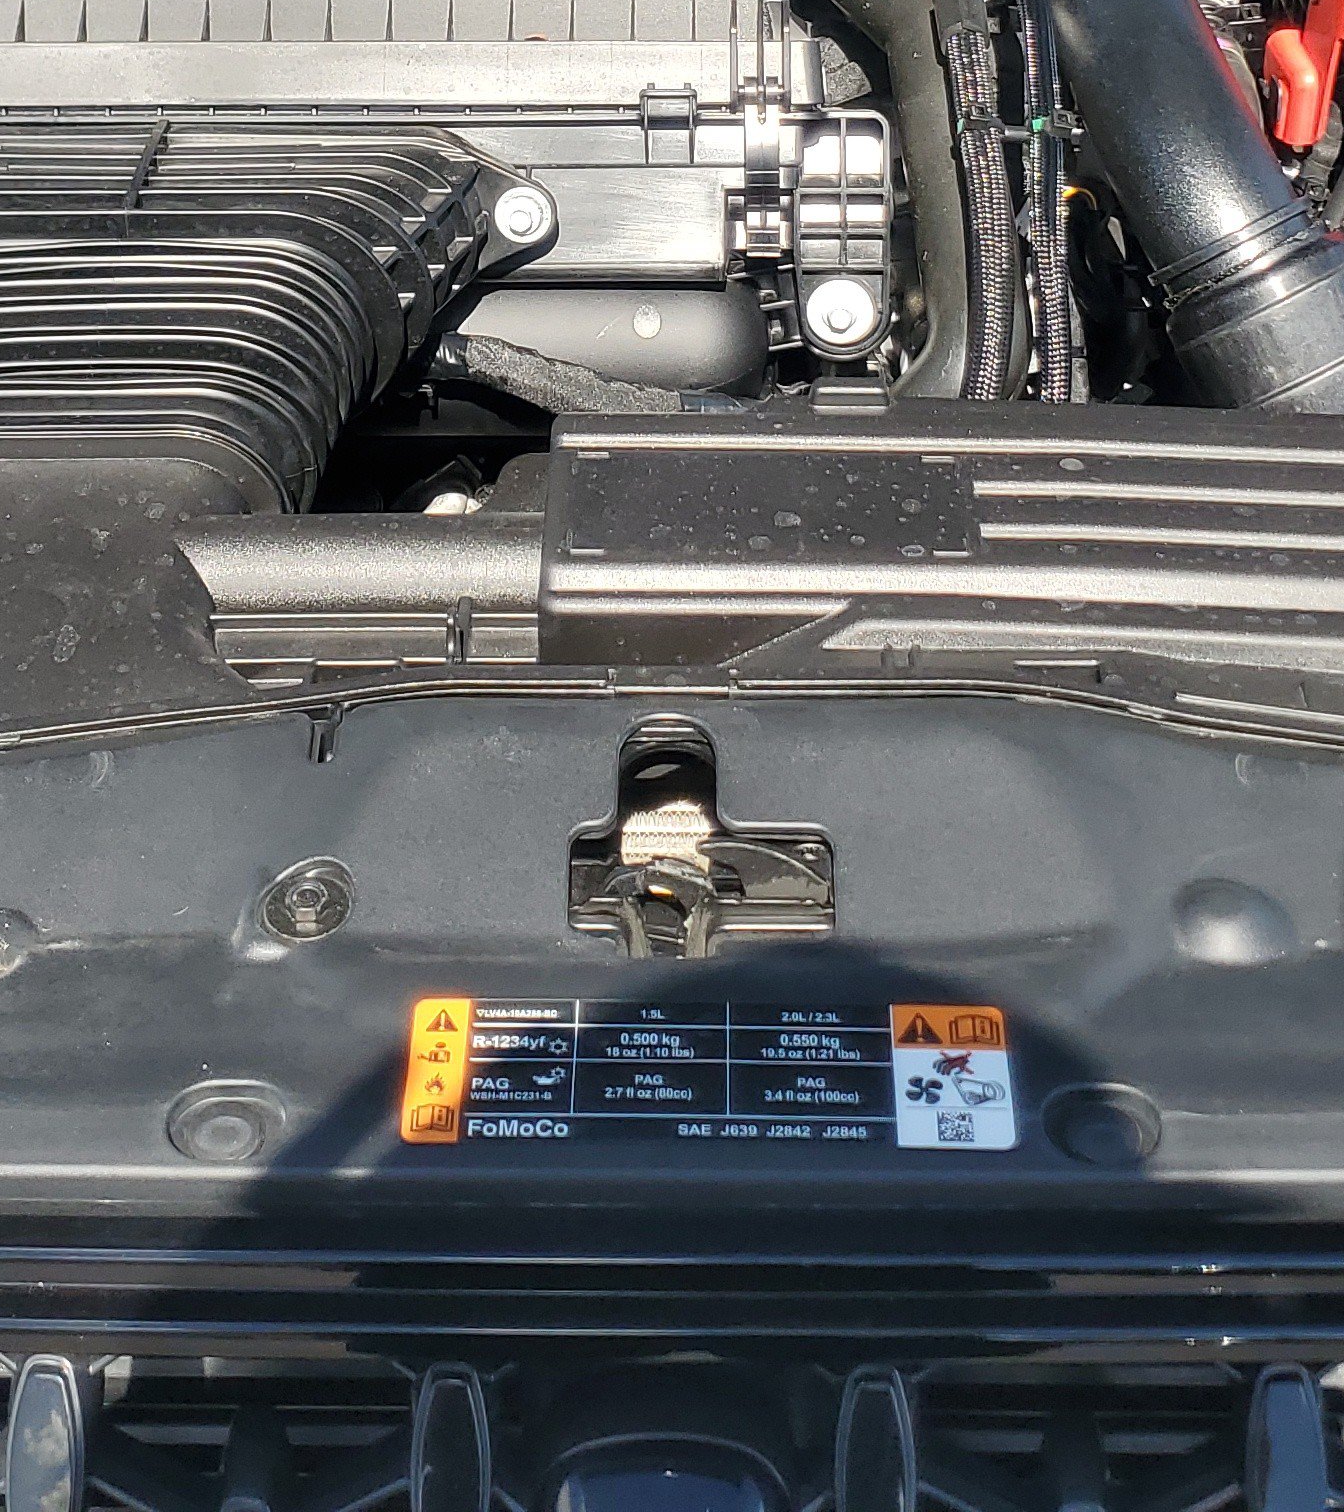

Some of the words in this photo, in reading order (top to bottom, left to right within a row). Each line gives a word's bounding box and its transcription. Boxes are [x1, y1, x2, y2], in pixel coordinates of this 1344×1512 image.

[641, 1008, 666, 1020] 1.5L
[781, 1011, 807, 1023] 2.0L
[472, 1034, 546, 1049] R-1234yf
[620, 1032, 659, 1046] 0.500
[662, 1032, 681, 1048] kg
[779, 1033, 819, 1047] 0.550
[821, 1033, 841, 1049] kg
[622, 1048, 638, 1058] oz
[671, 1047, 695, 1059] lbs)
[788, 1049, 804, 1059] oz
[837, 1048, 862, 1061] lbs)
[472, 1076, 510, 1090] PAG
[634, 1073, 664, 1086] PAG
[796, 1076, 827, 1089] PAG
[604, 1086, 624, 1099] 2.7
[626, 1086, 635, 1099] fl
[637, 1089, 653, 1099] oz
[763, 1089, 783, 1102] 3.4
[785, 1089, 794, 1102] fl
[796, 1091, 813, 1102] oz
[467, 1118, 570, 1138] FoMoCo
[678, 1122, 712, 1137] SAE
